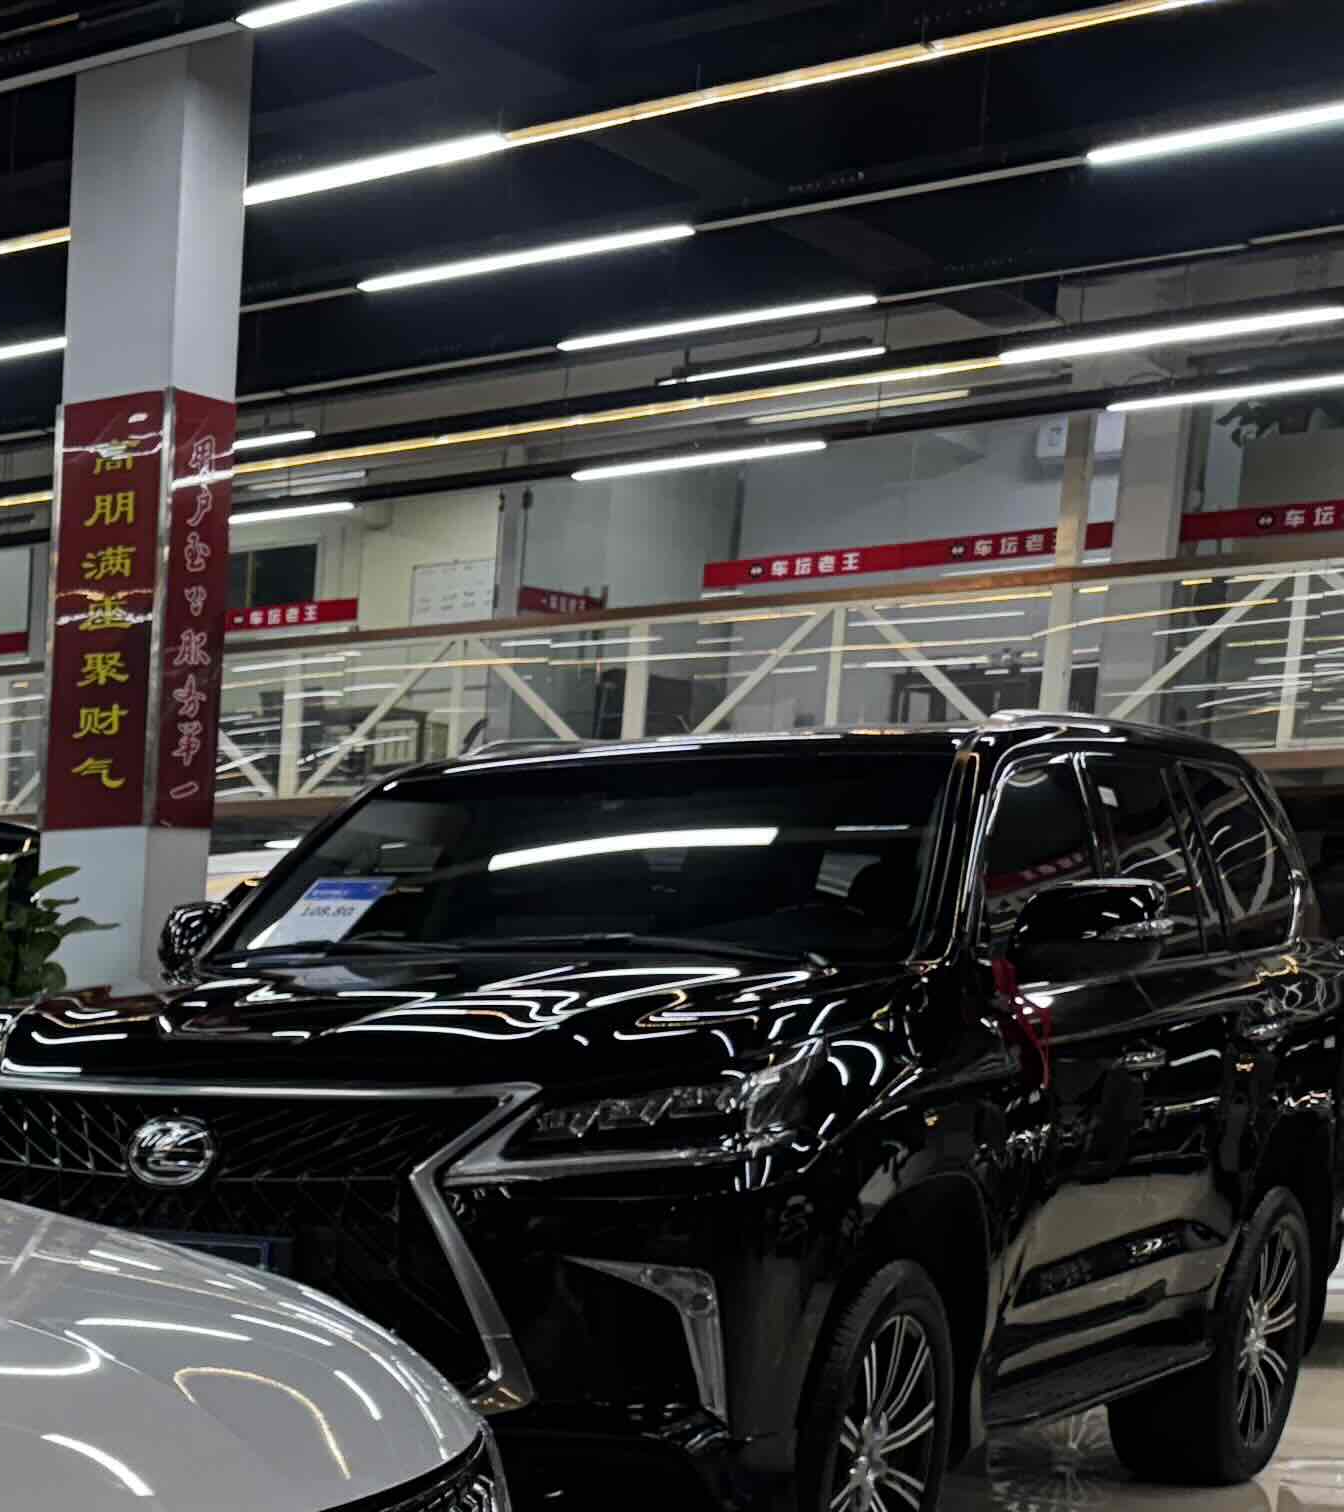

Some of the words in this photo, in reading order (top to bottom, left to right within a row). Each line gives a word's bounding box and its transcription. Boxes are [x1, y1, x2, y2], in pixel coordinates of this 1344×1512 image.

[1284, 506, 1344, 527] 车坛
[974, 533, 1057, 558] 车坛老
[771, 551, 862, 577] 车坛老王
[249, 604, 319, 625] 车坛老王
